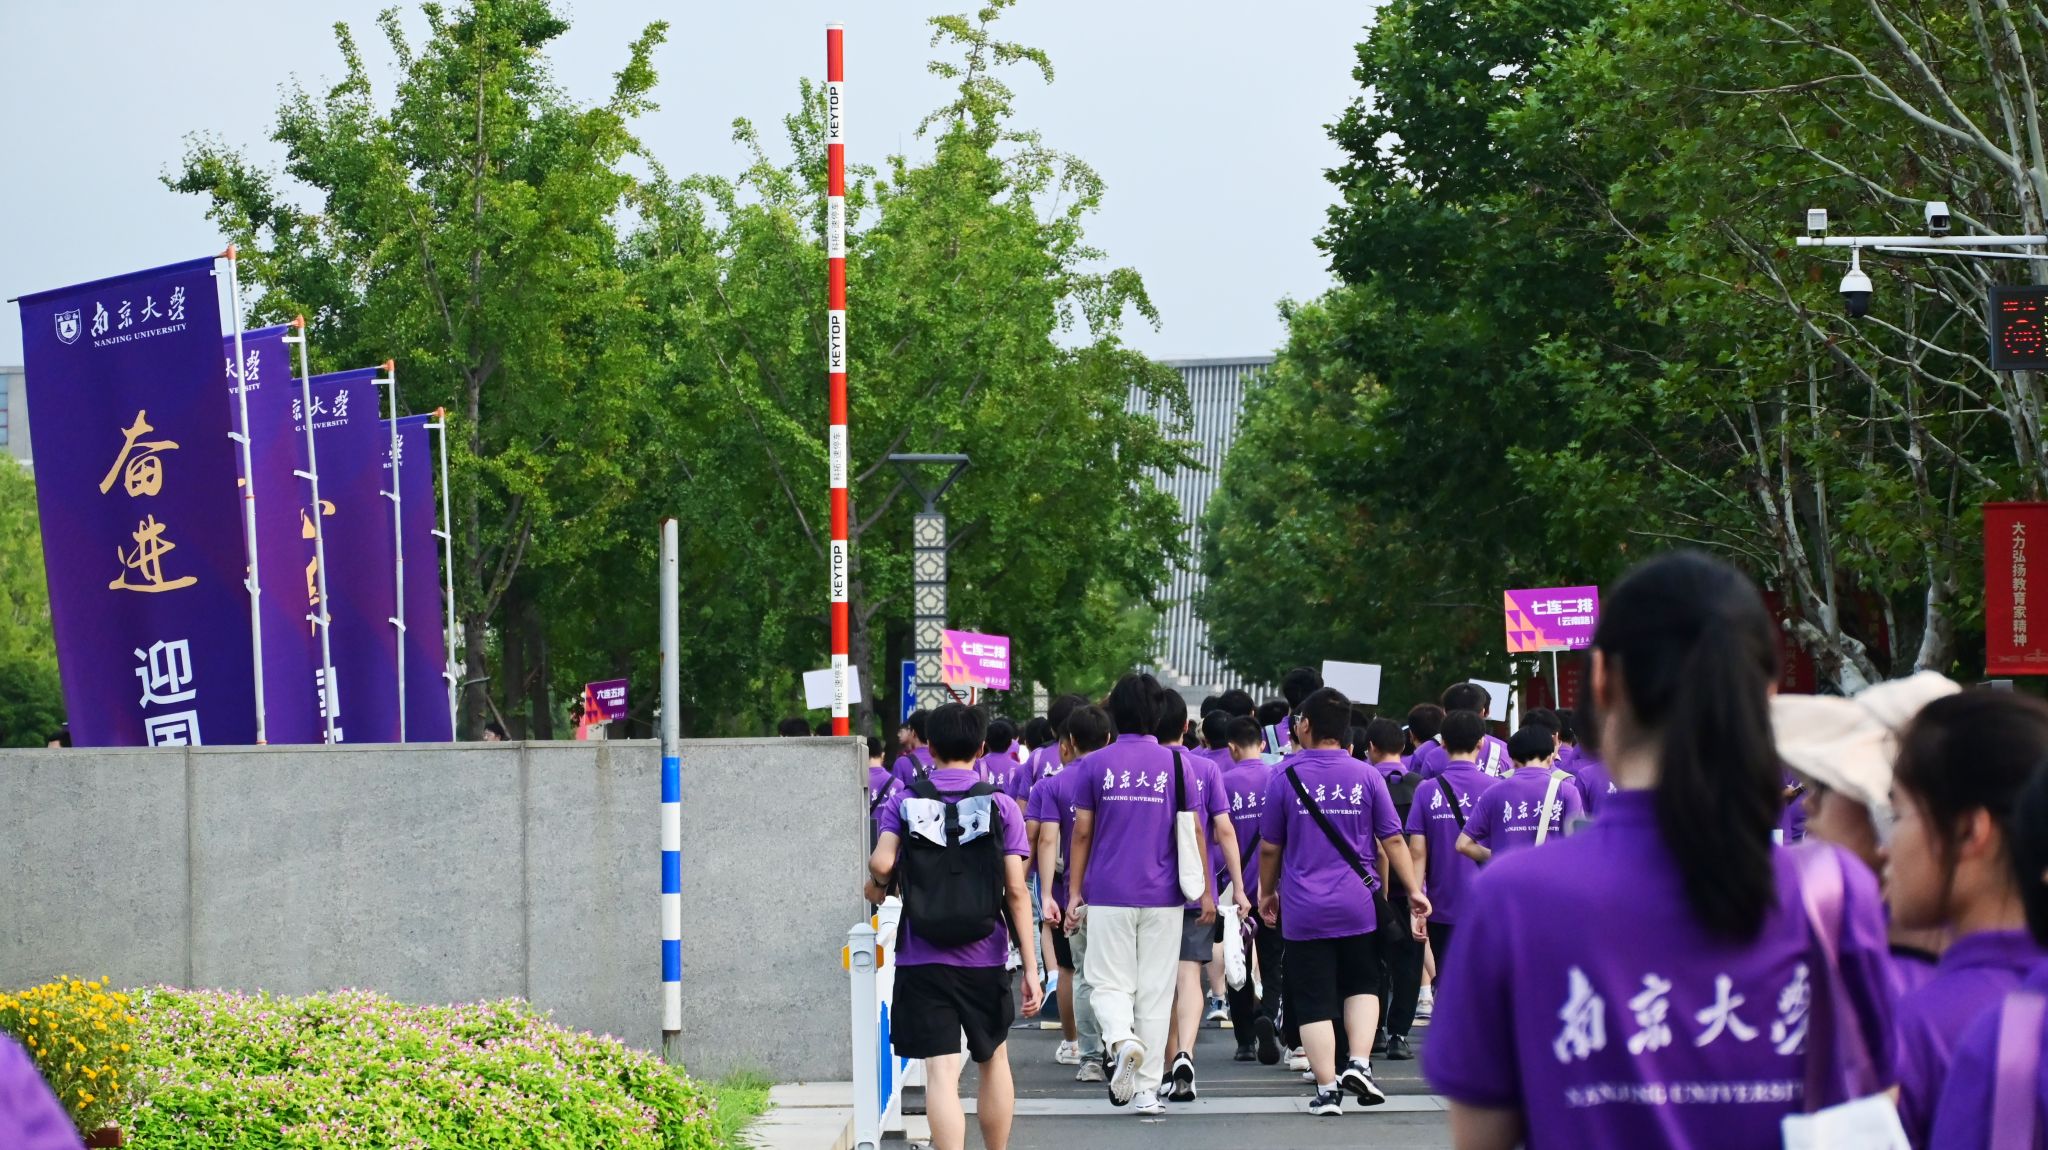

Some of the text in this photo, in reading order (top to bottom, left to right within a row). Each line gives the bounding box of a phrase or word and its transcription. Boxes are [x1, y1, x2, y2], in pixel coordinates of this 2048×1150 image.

[830, 87, 839, 138] KEYTOP
[94, 323, 187, 348] NANJING UNIVERSITY
[832, 315, 840, 367] KEYTOP
[302, 418, 349, 431] UIVERSITY
[99, 409, 198, 593] 奋进
[834, 545, 842, 597] KEYTOP
[2012, 521, 2027, 647] 大力弘扬教育家精神
[1531, 598, 1593, 615] 七连二排
[1130, 796, 1164, 804] UNIVERSITY
